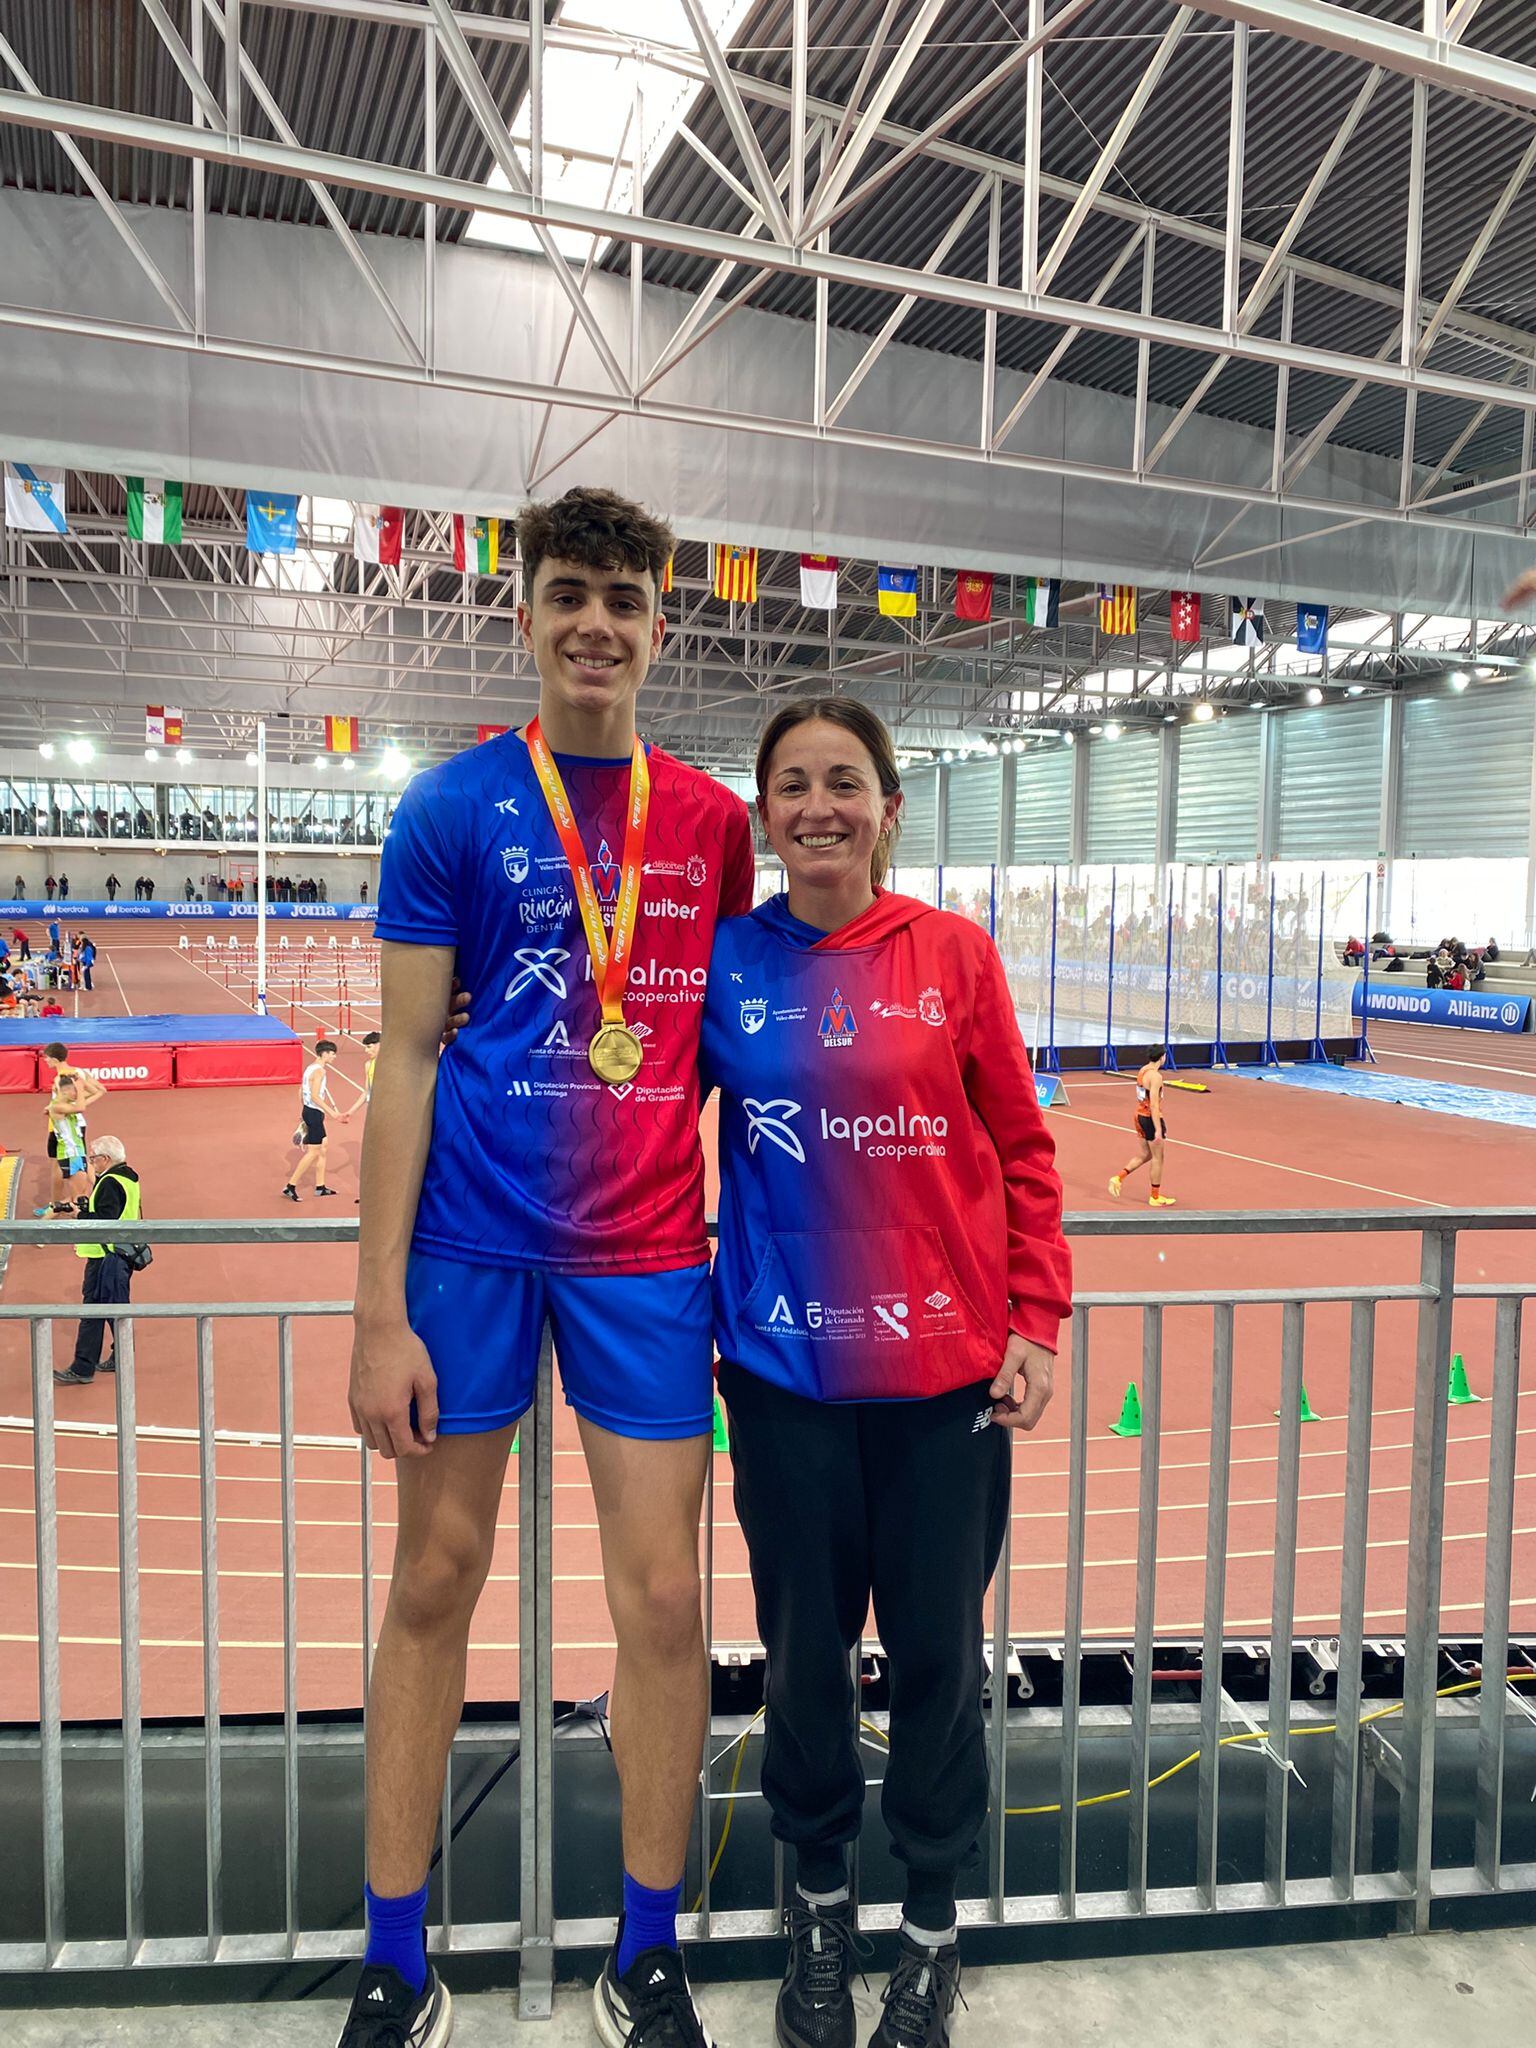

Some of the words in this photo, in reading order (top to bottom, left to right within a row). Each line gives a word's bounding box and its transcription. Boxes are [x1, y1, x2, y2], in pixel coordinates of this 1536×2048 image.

[644, 898, 700, 920] wiber
[526, 922, 565, 934] DENTAL
[585, 954, 707, 987] lalma
[1370, 994, 1431, 1013] MONDO
[1448, 999, 1498, 1020] Allianz
[823, 1037, 853, 1048] DELSUR
[533, 1081, 569, 1090] Diputación
[569, 1082, 601, 1090] Provincial
[636, 1085, 684, 1095] Diputación
[634, 1094, 646, 1102] de
[647, 1092, 685, 1102] Granada
[821, 1105, 948, 1151] lapalma
[824, 1306, 864, 1316] Diputación
[825, 1317, 833, 1325] de
[833, 1315, 865, 1325] Granada
